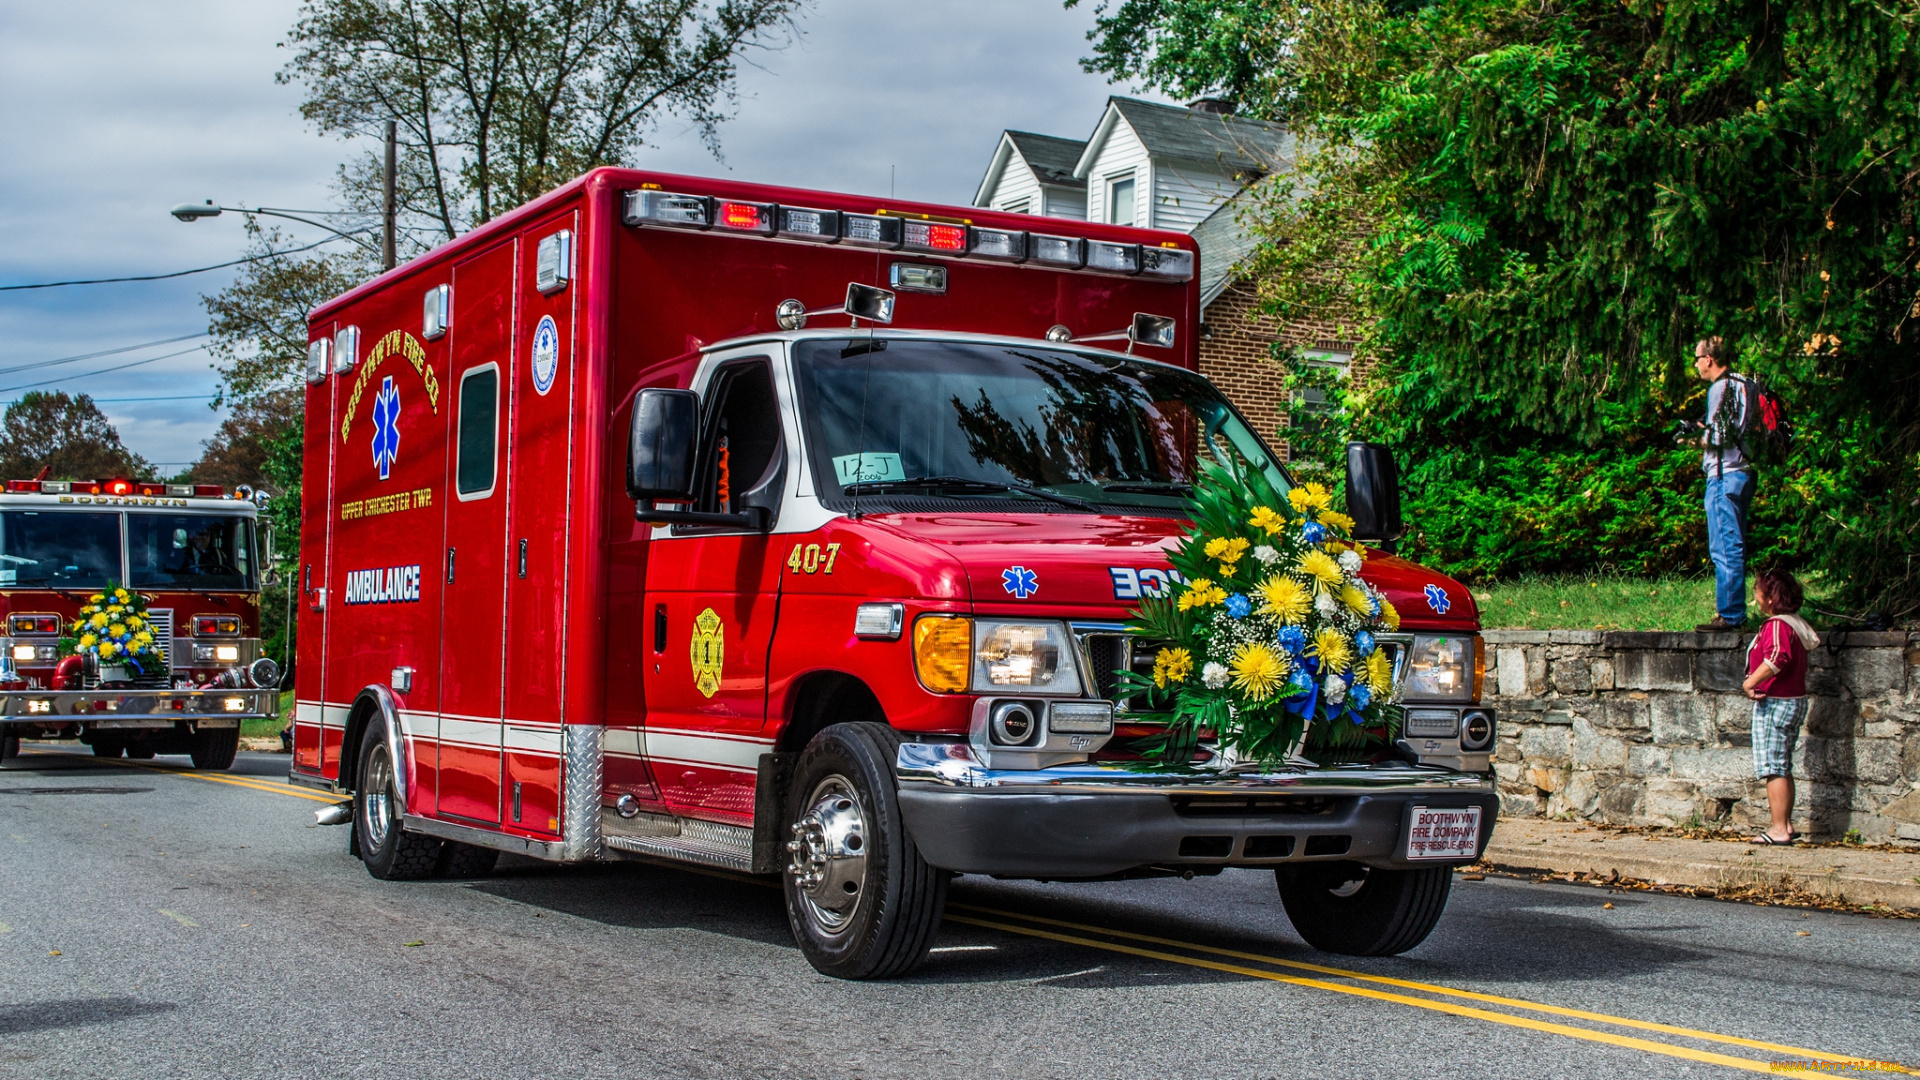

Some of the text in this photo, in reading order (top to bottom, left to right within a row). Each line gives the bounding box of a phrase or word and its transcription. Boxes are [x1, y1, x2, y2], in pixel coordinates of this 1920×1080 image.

[341, 329, 402, 445] BOOTHWYN
[402, 331, 426, 377] FIRE
[59, 496, 188, 507] BOOTHWYN
[341, 488, 432, 521] UPPER CHICHESTER TWP.
[787, 543, 841, 575] 40-7
[344, 564, 421, 606] AMBULANCE
[1411, 826, 1477, 838] FIRE COMPANY
[1418, 813, 1474, 825] BOOTHWYN
